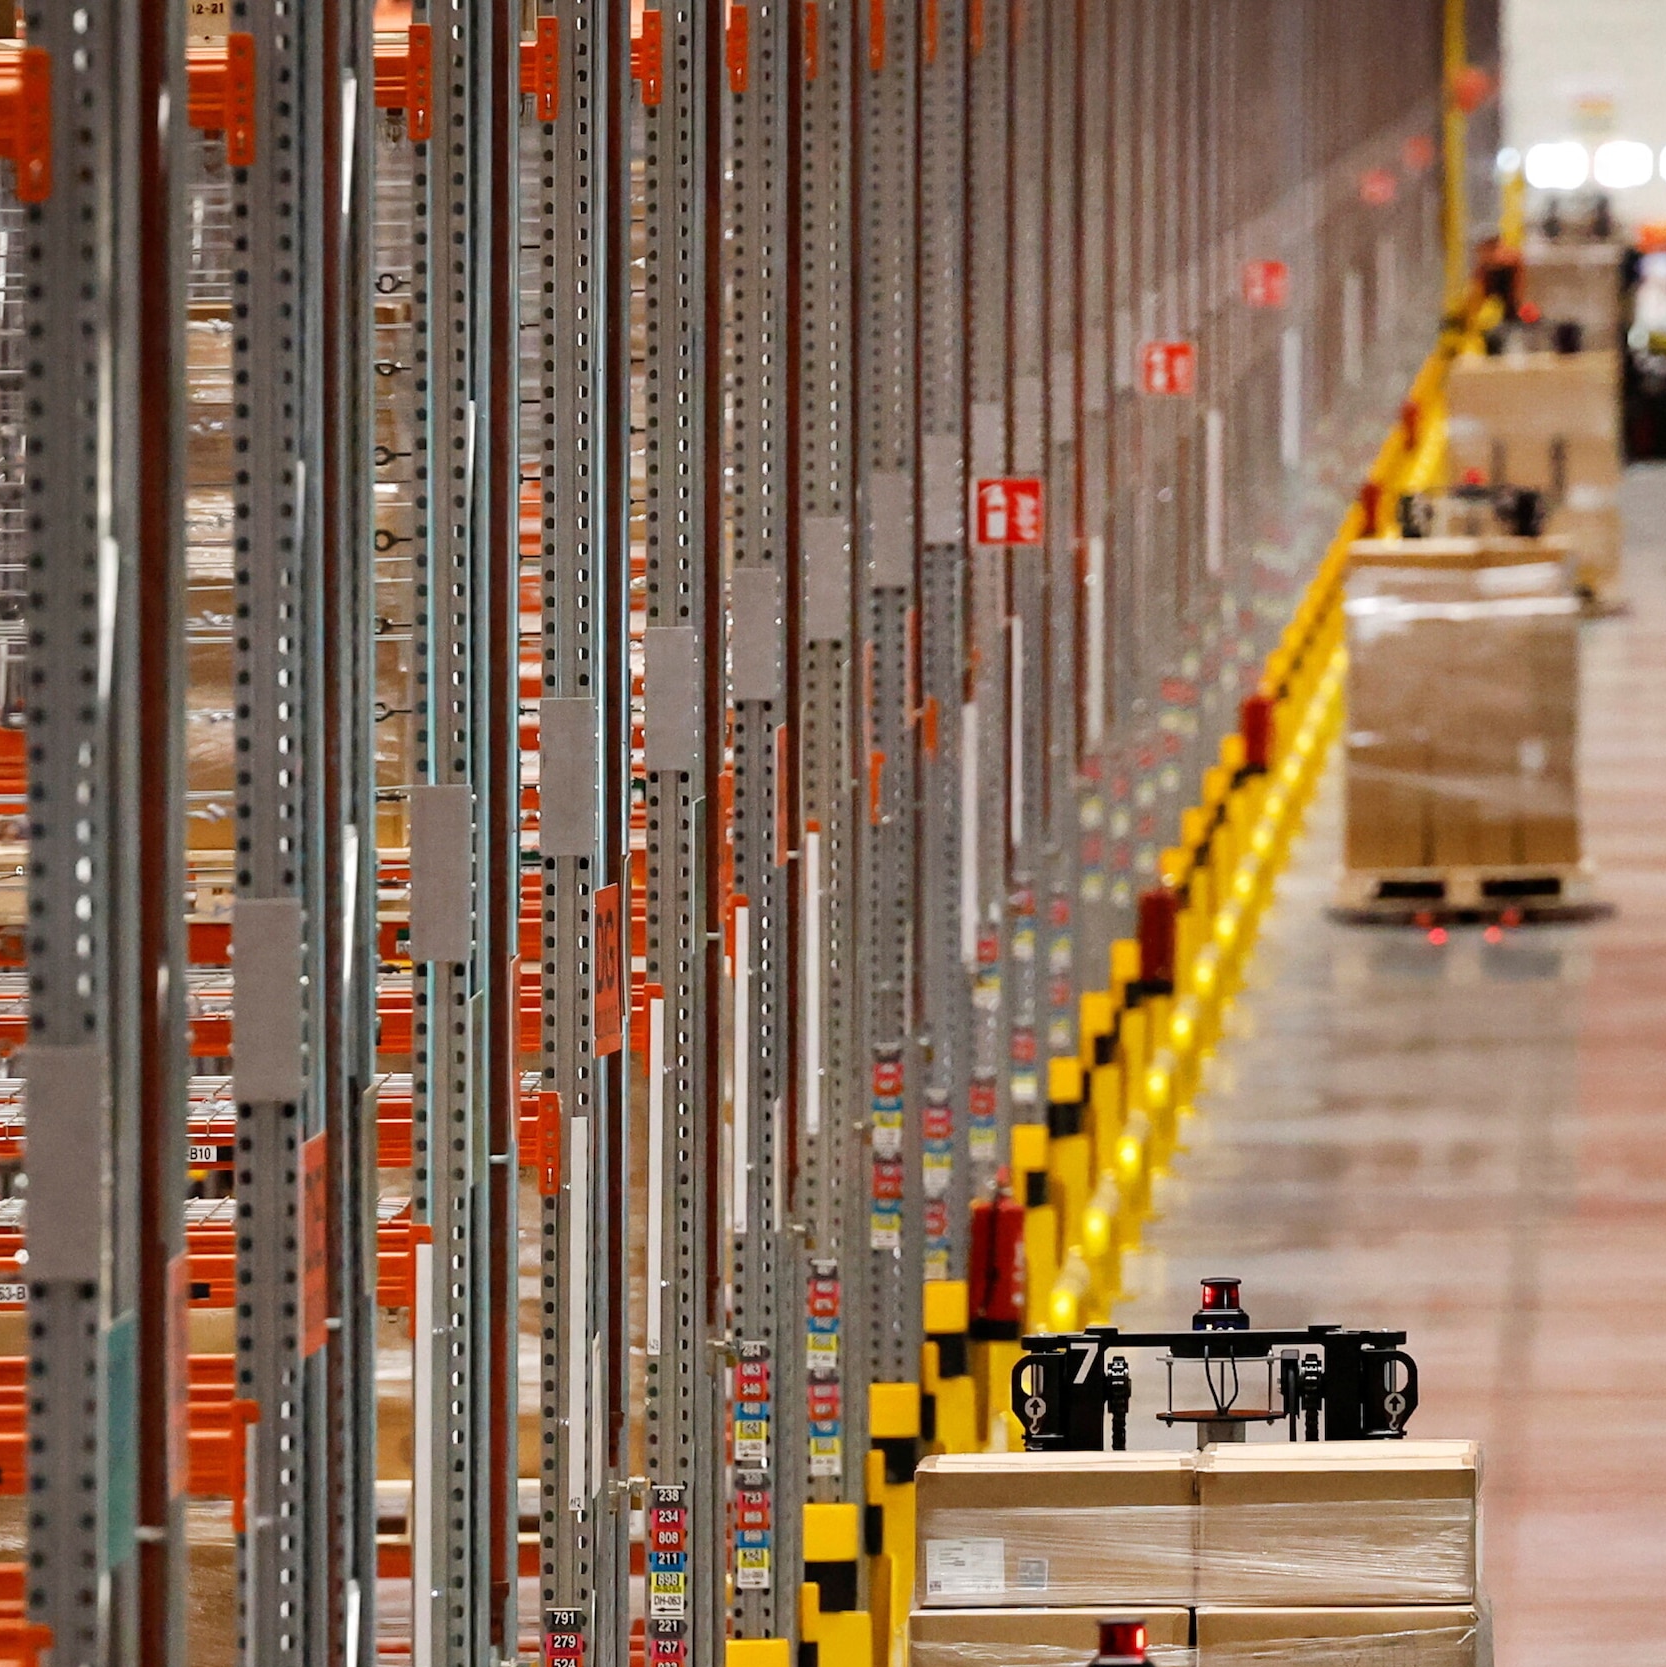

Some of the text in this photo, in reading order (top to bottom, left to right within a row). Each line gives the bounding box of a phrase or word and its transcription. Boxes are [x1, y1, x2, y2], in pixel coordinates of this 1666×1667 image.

[1070, 1342, 1099, 1384] 7
[658, 1489, 679, 1502] 238
[658, 1510, 679, 1523] 234
[658, 1552, 679, 1565] 211
[654, 1595, 681, 1606] DH-063
[553, 1611, 576, 1625] 791
[657, 1620, 678, 1632] 221
[553, 1635, 576, 1649] 279
[657, 1640, 678, 1654] 737
